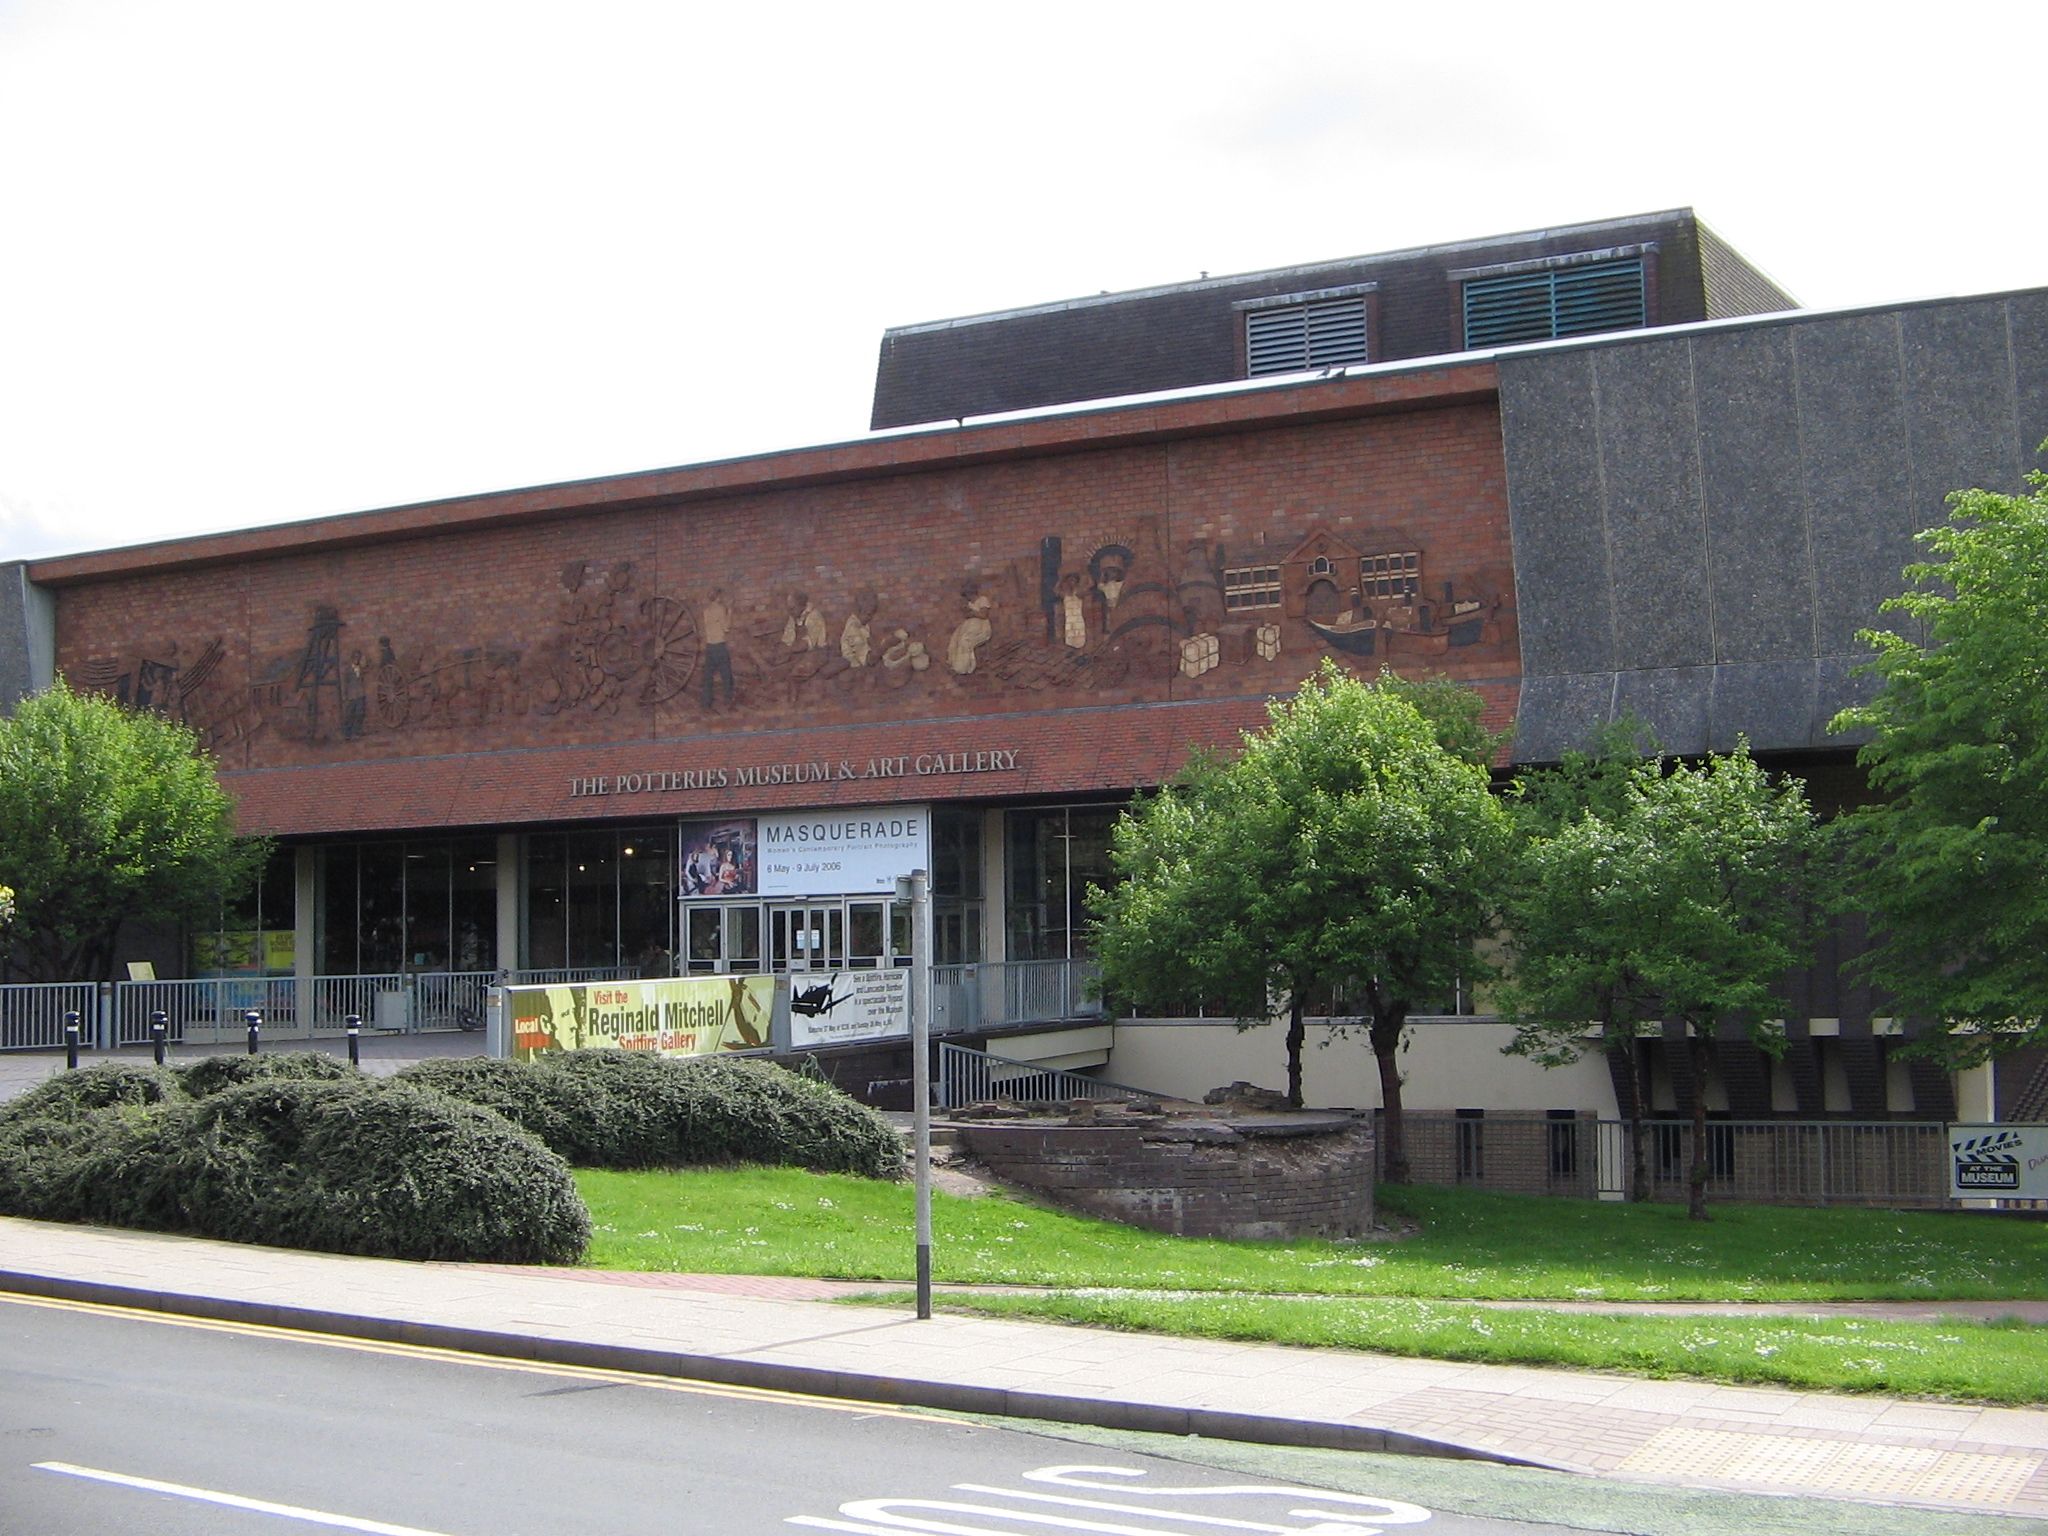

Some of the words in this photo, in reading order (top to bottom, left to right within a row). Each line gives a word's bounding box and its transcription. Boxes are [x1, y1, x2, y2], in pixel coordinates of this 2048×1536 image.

[569, 777, 609, 797] THE
[616, 768, 728, 794] POTTERIES
[734, 762, 832, 787] MUSEUM
[839, 760, 857, 780] &
[864, 756, 909, 778] ART
[915, 749, 1020, 775] GALLERY
[767, 820, 918, 843] MASQUERADE
[774, 863, 790, 874] May
[797, 863, 802, 872] 9
[804, 863, 819, 873] July
[821, 862, 841, 871] 2006
[593, 990, 613, 1006] Visit
[615, 990, 628, 1004] the
[515, 1018, 539, 1034] Local
[589, 1004, 659, 1040] Reginald
[664, 999, 724, 1030] Mitchell
[619, 1033, 658, 1050] Spitfire
[661, 1032, 696, 1051] Gallery
[1976, 1139, 2023, 1156] MOVIES
[1961, 1172, 2014, 1183] MUSEUM
